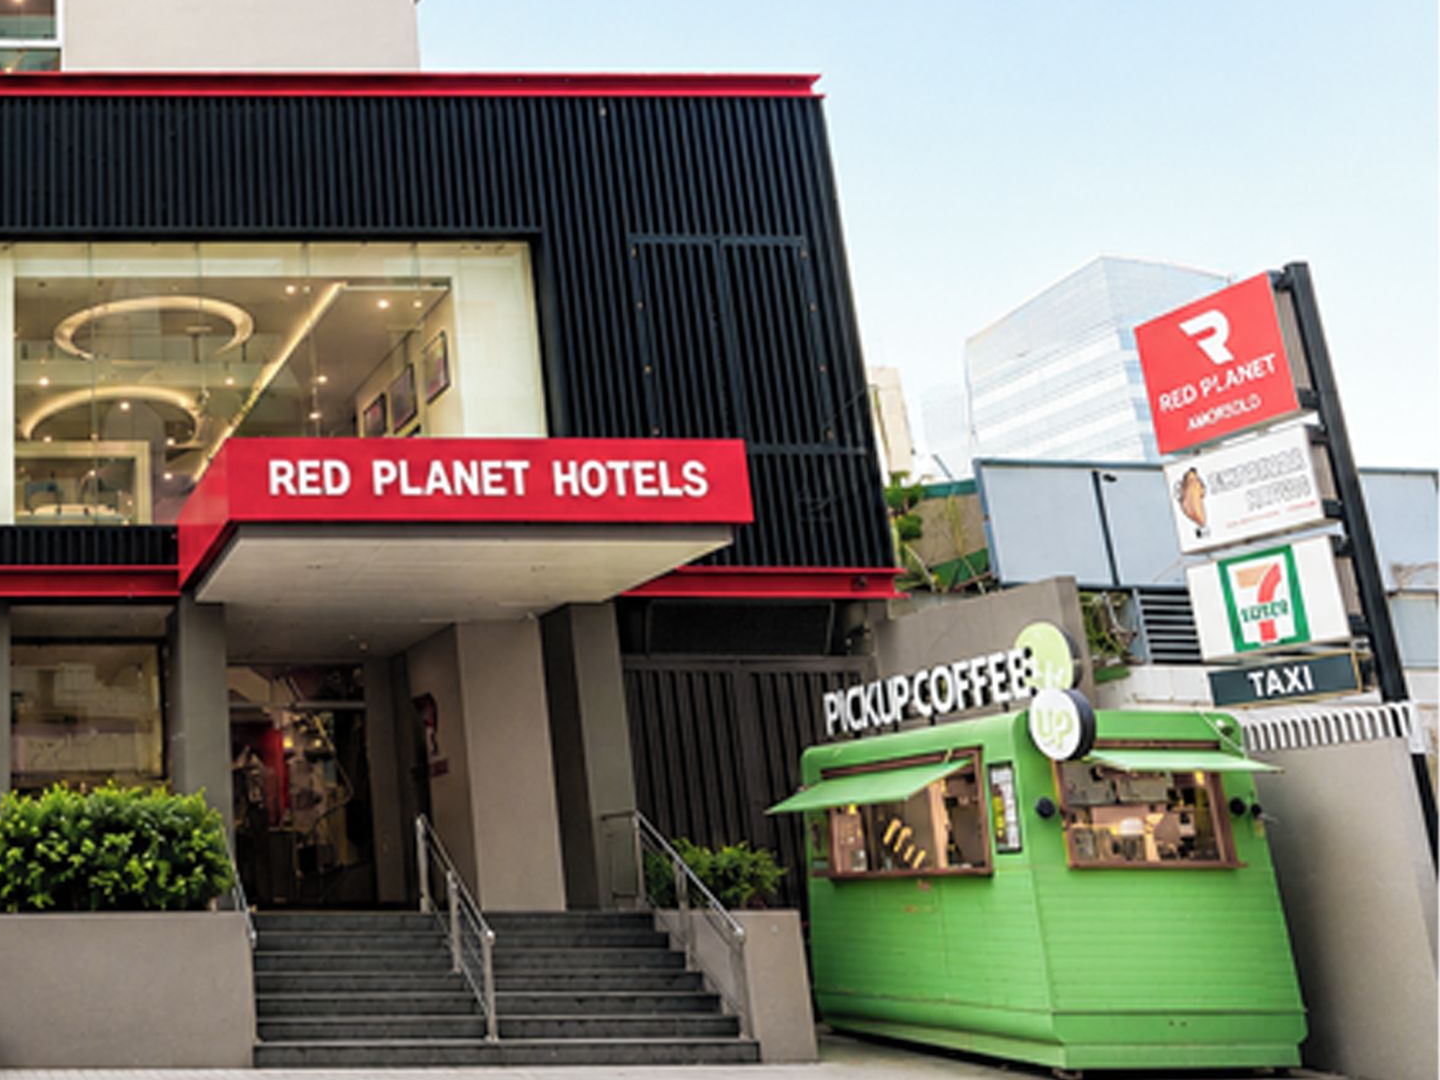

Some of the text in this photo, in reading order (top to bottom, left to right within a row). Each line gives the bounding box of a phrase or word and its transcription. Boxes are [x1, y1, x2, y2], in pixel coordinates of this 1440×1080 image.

[1159, 352, 1276, 412] RED PLANET
[268, 459, 710, 498] RED PLANET HOTELS
[823, 675, 910, 736] PICKUP
[1247, 665, 1315, 698] TAXI
